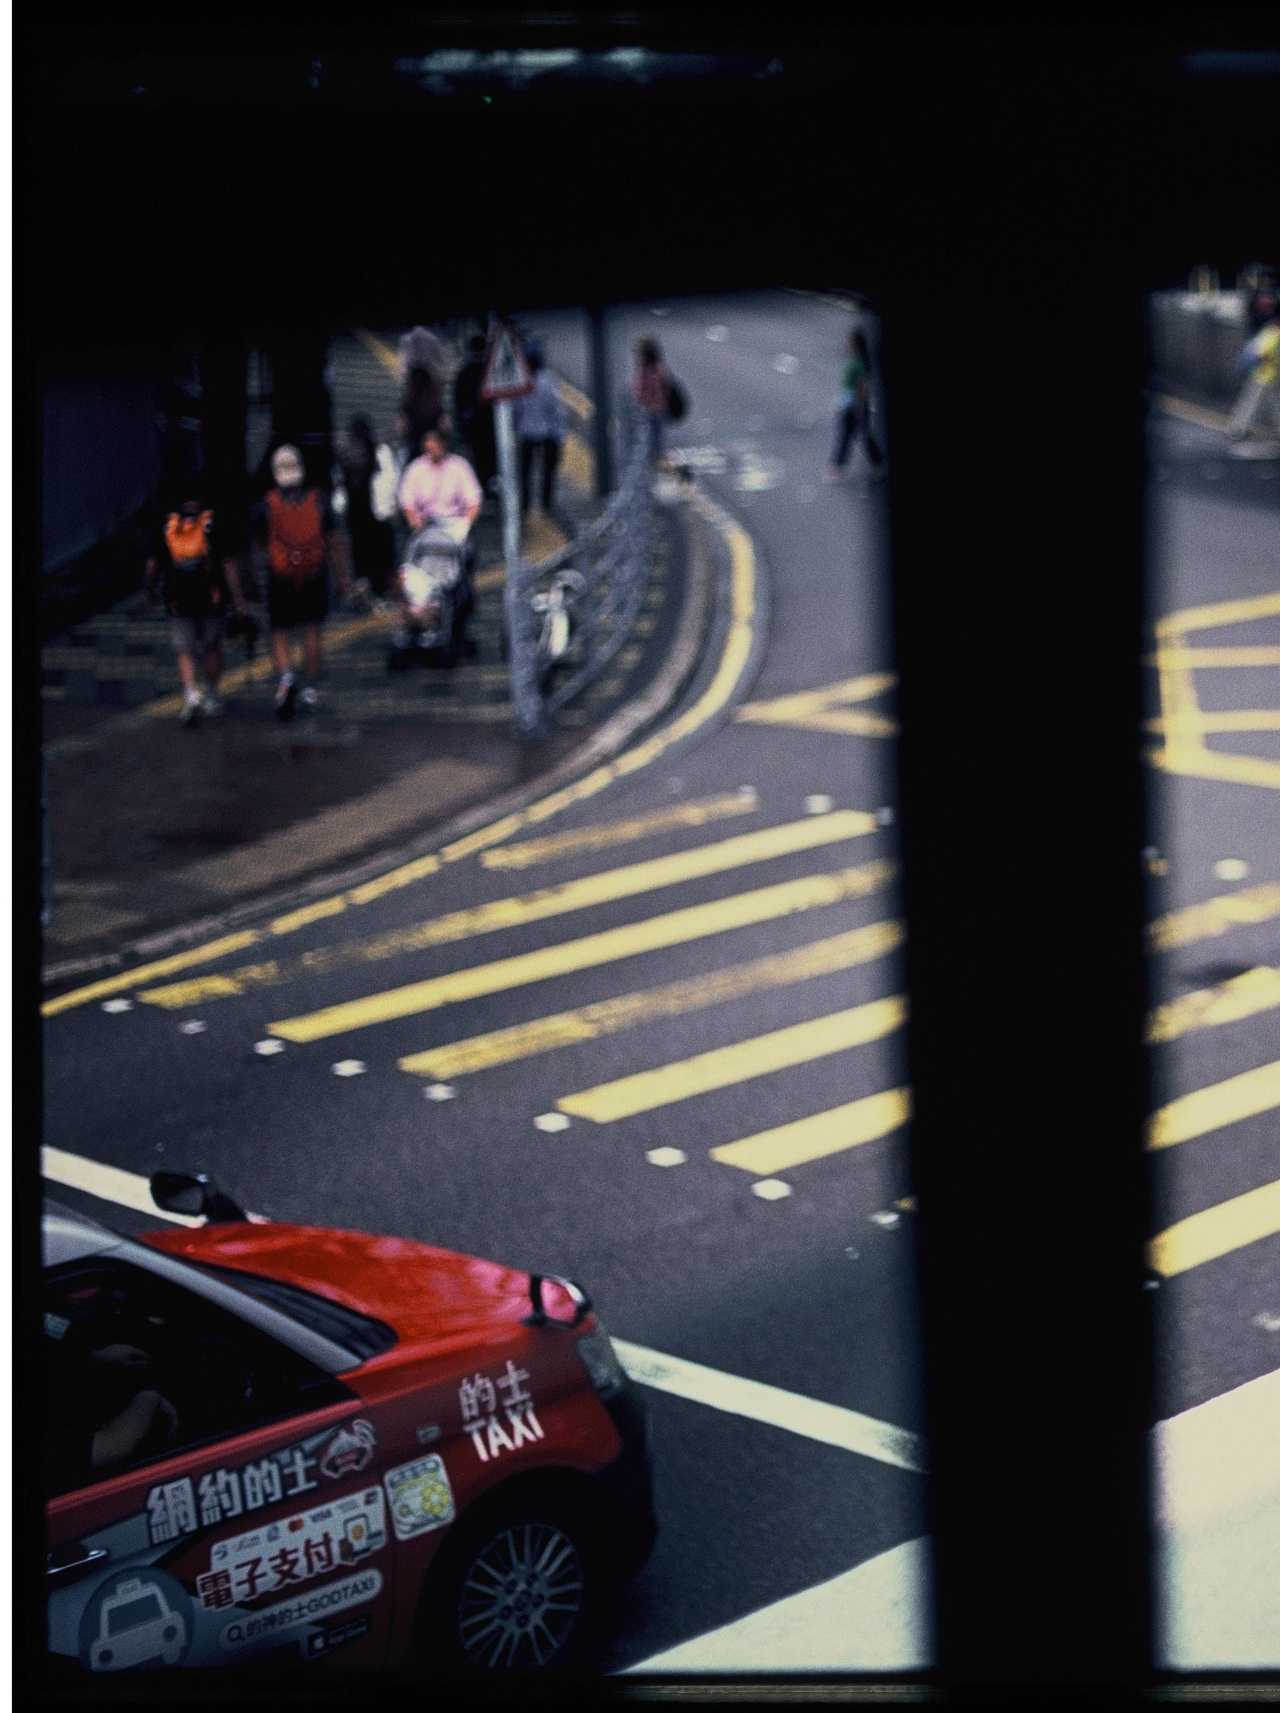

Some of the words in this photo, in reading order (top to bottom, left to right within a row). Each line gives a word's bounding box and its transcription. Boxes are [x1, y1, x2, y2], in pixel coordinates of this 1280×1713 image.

[459, 1360, 531, 1421] 的士
[463, 1401, 545, 1462] TAXI
[147, 1451, 320, 1544] 網約的士
[310, 1508, 333, 1524] VISA
[199, 1531, 333, 1609] 電子支付
